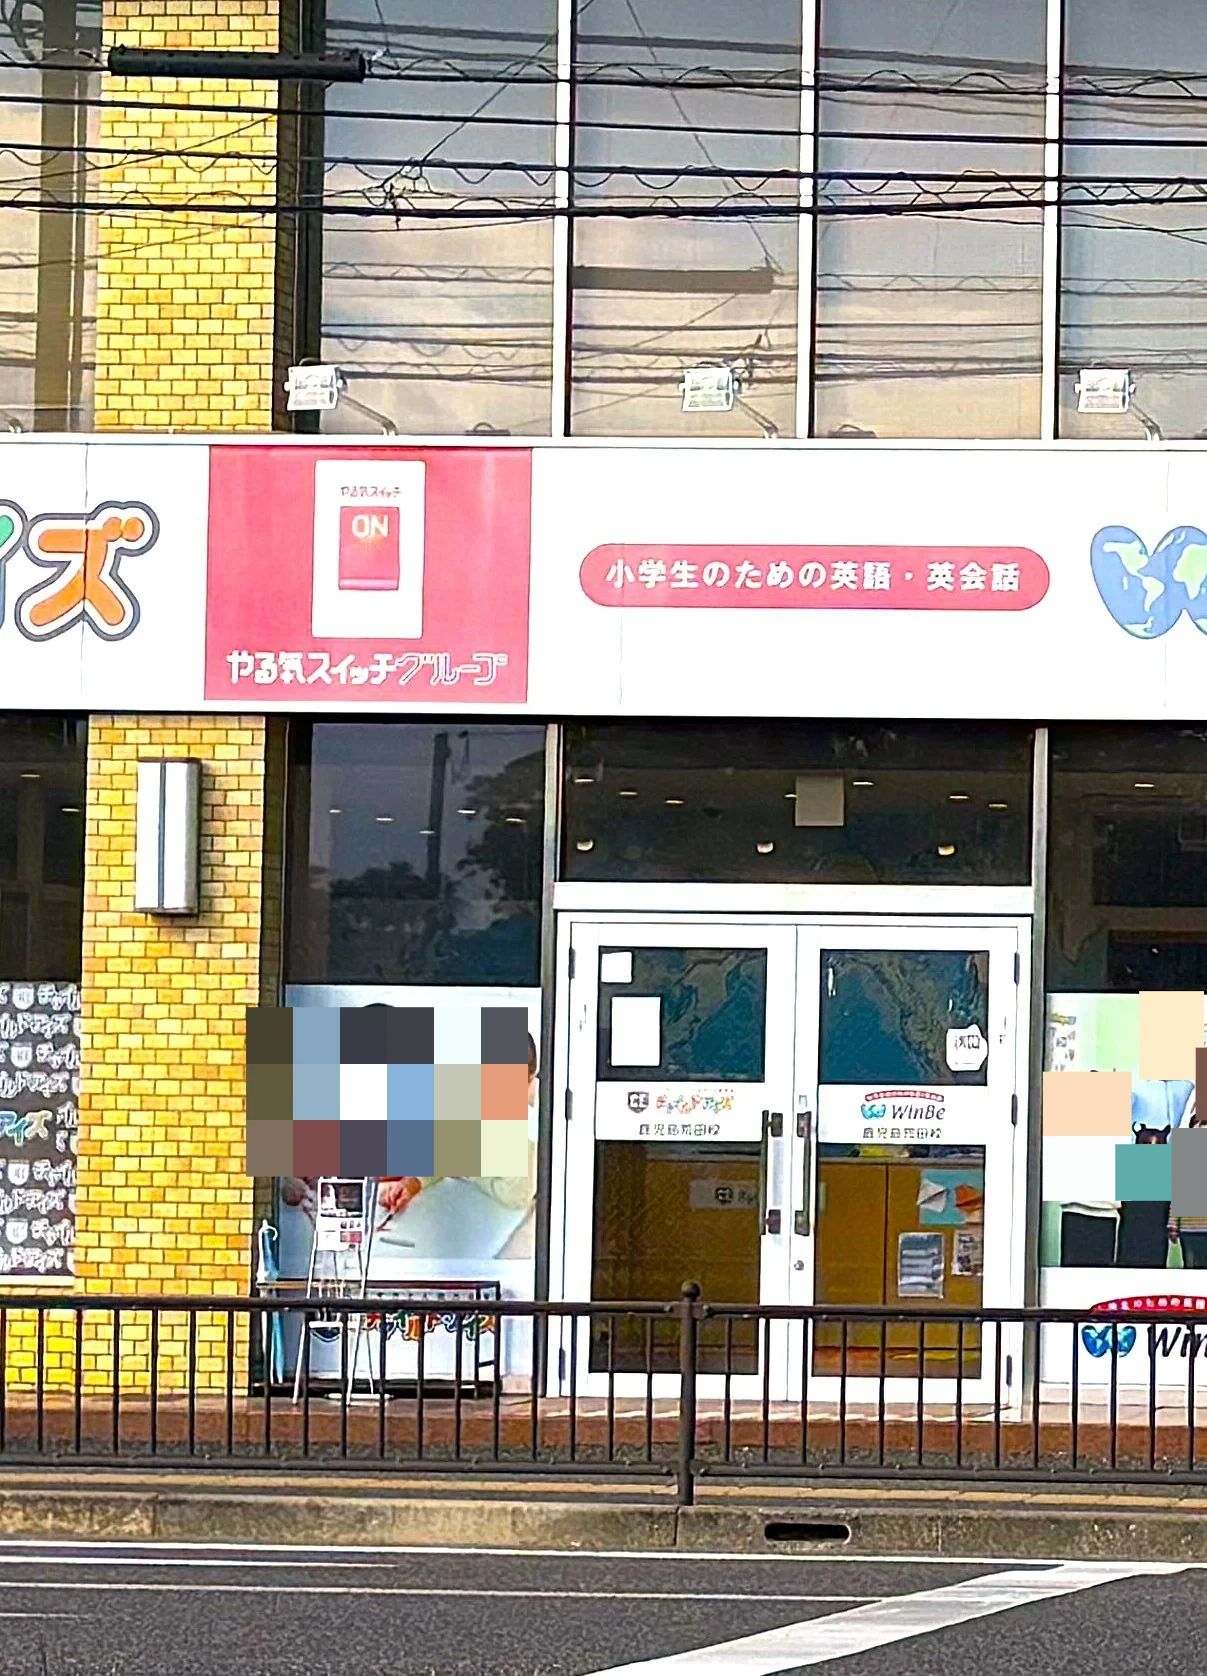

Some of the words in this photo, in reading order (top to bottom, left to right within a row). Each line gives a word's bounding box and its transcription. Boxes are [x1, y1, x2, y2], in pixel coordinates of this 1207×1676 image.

[351, 513, 389, 540] ON
[0, 499, 161, 643] ズ
[604, 558, 1022, 593] 小学生のための英語・英会話
[226, 648, 509, 687] やる気スイッチグループ
[891, 1103, 947, 1121] WinBe
